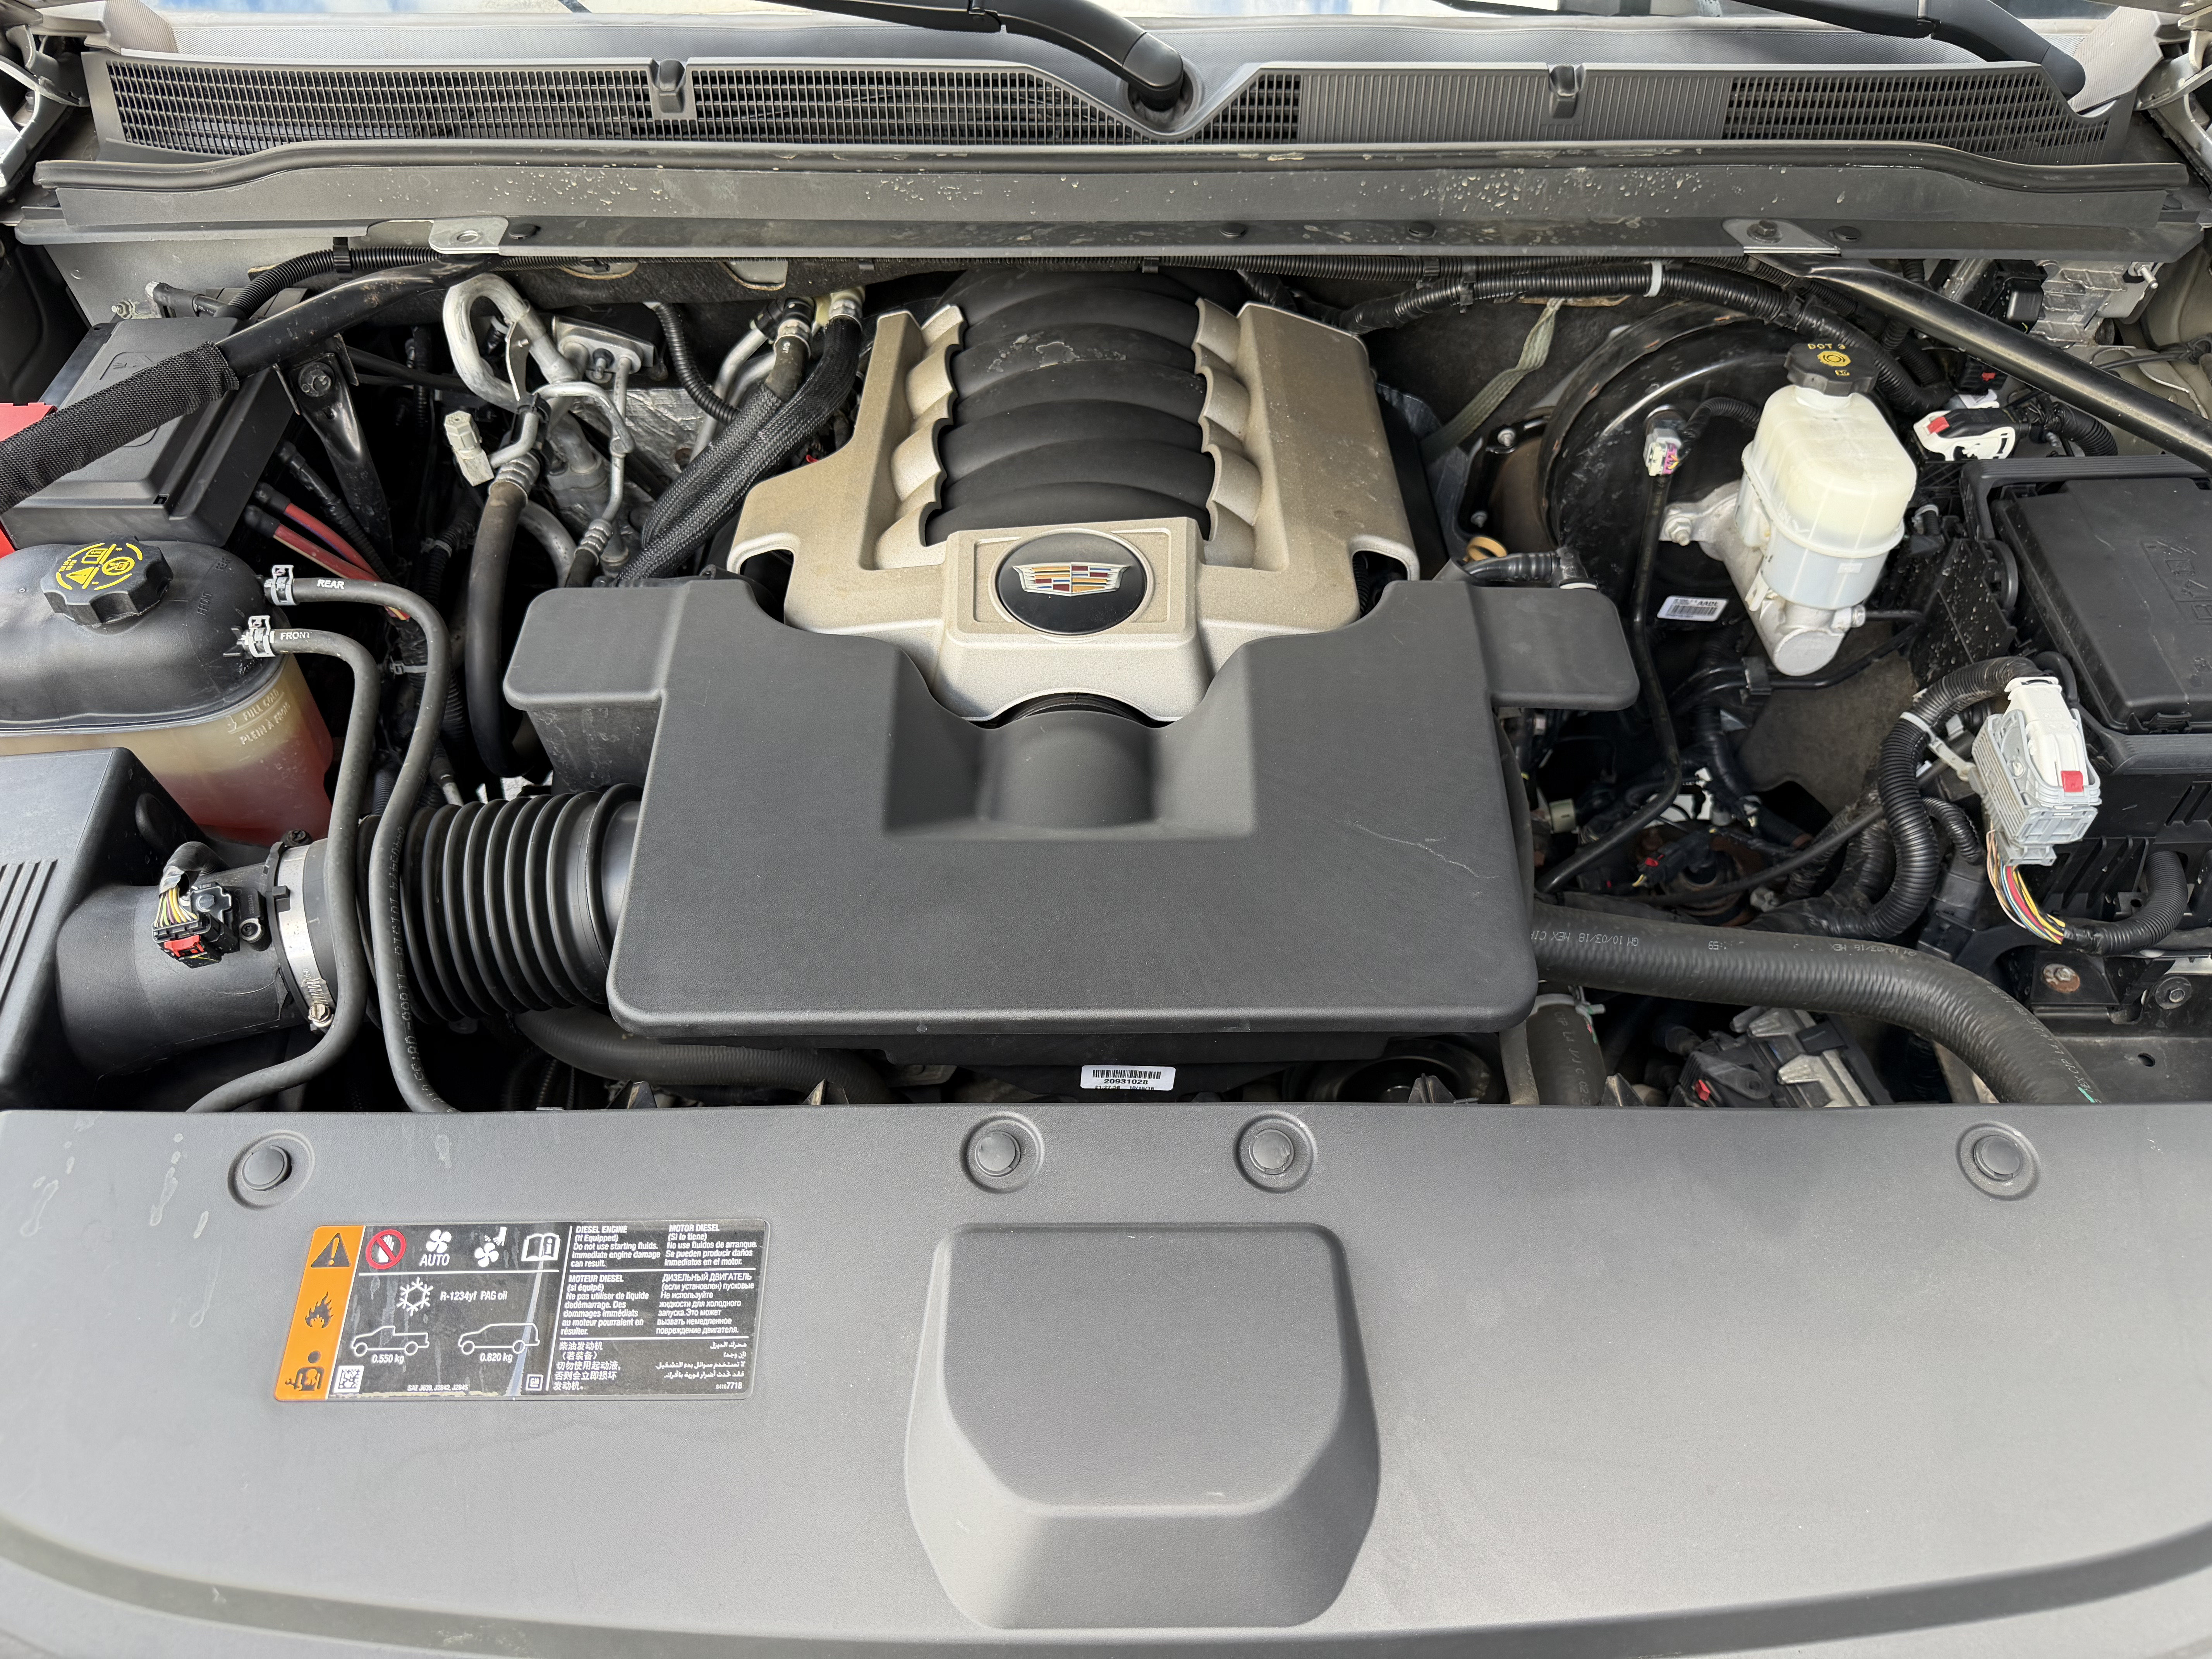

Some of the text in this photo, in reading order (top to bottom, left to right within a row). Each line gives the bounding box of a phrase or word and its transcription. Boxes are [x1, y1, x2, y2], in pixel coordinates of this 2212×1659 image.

[317, 579, 345, 589] REAR
[280, 631, 312, 640] FRONT
[242, 704, 263, 721] FULL
[1551, 931, 1571, 942] MEX
[1578, 933, 1623, 945] 10/03/18
[1627, 937, 1639, 946] GM
[575, 1225, 628, 1233] DIESEL ENGINE
[696, 1223, 720, 1231] DIESEL
[574, 1234, 618, 1243] (If Equipped)
[668, 1233, 678, 1242] (Si
[687, 1232, 707, 1241] tiene)
[610, 1242, 637, 1251] starting
[725, 1241, 757, 1250] arranque.
[609, 1250, 632, 1260] engine
[633, 1250, 661, 1259] damage
[676, 1249, 701, 1258] pueden
[702, 1249, 731, 1258] producir
[419, 1254, 450, 1266] AUTO
[568, 1274, 624, 1283] MOTEUR DIESEL
[662, 1273, 752, 1282] ДИЗЕЛЬНЫЙ ДВИГАТЕЛЬ
[567, 1283, 604, 1293] (si équipé)
[661, 1282, 754, 1291] (если установлен) пусковые
[440, 1290, 508, 1302] R-1234yf PAG oil
[591, 1291, 615, 1300] utiliser
[626, 1291, 649, 1301] liquide
[660, 1291, 713, 1300] Не используйте
[563, 1309, 638, 1319] dommages immédiats
[572, 1318, 597, 1326] moteur
[598, 1318, 634, 1328] pourraient
[560, 1327, 588, 1335] résulter.
[558, 1341, 603, 1350] 柴油发动机
[372, 1354, 405, 1365] 0.550 kg
[479, 1352, 513, 1363] 0.820 kg
[555, 1370, 617, 1381] 否则会立即损坏
